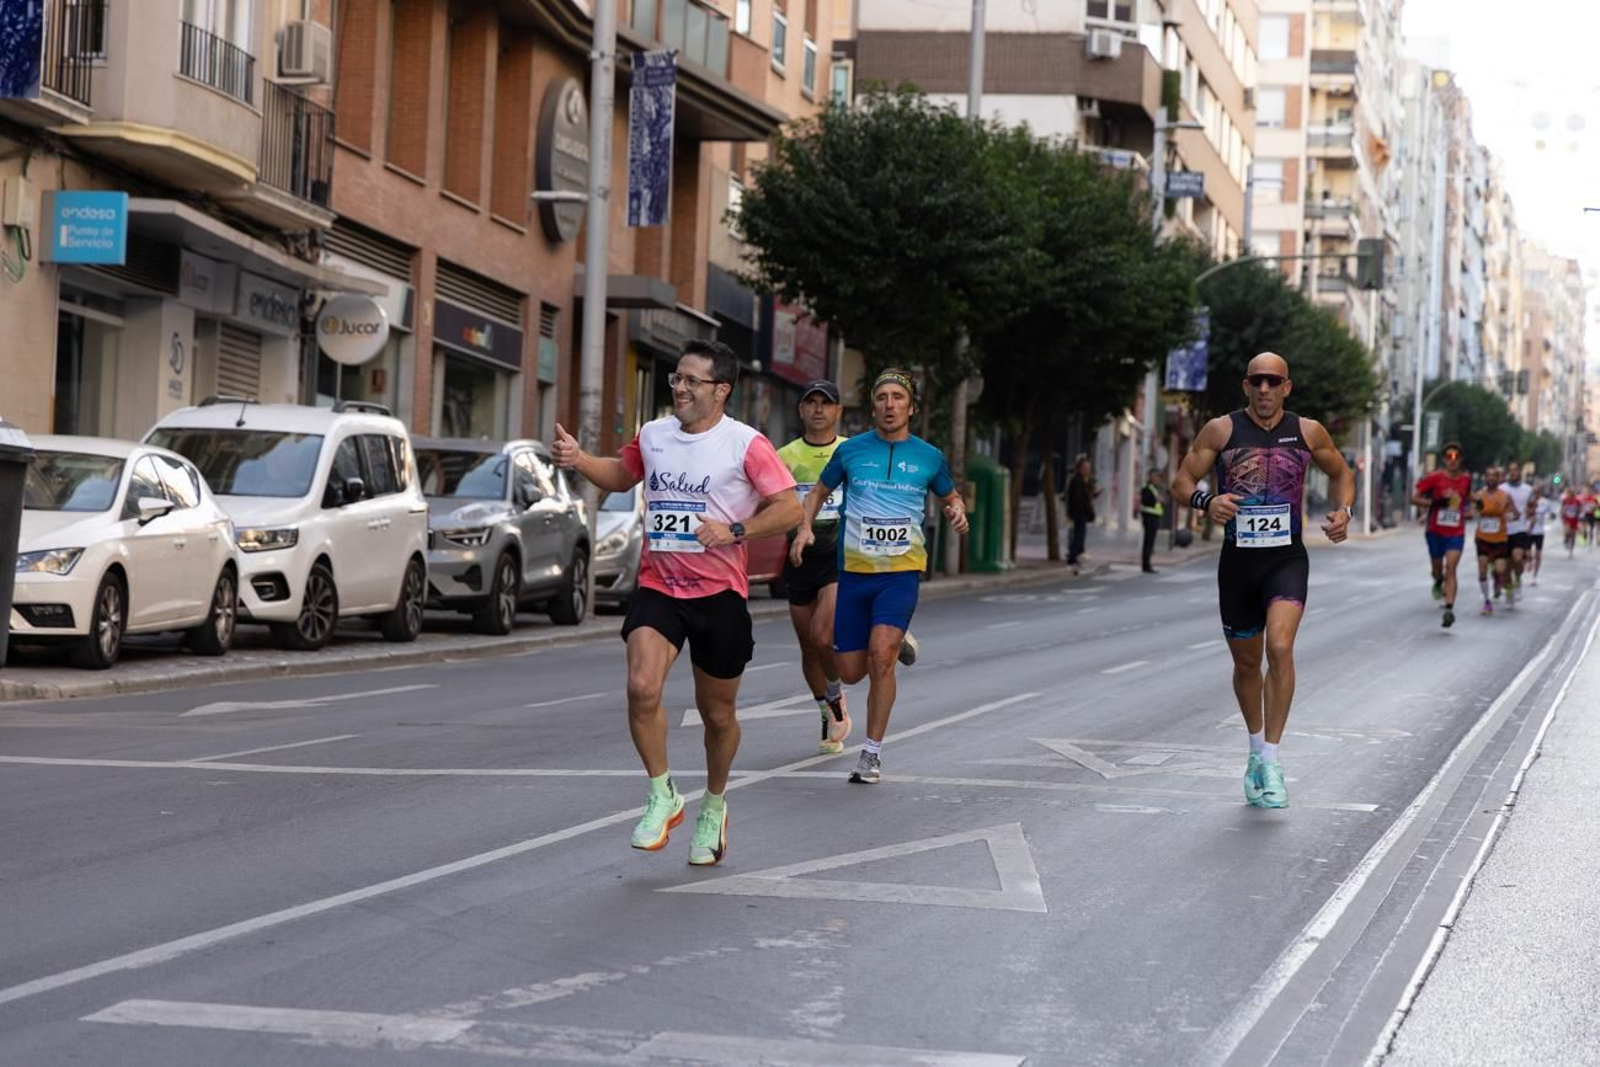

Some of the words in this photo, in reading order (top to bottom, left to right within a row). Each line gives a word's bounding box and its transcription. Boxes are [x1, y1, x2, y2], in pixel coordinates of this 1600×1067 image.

[61, 206, 116, 220] endesa
[69, 238, 114, 249] Servicio
[339, 319, 381, 335] Jucar
[659, 471, 711, 495] Salud
[653, 513, 691, 533] 321
[1247, 517, 1281, 532] 124
[866, 527, 907, 541] 1002
